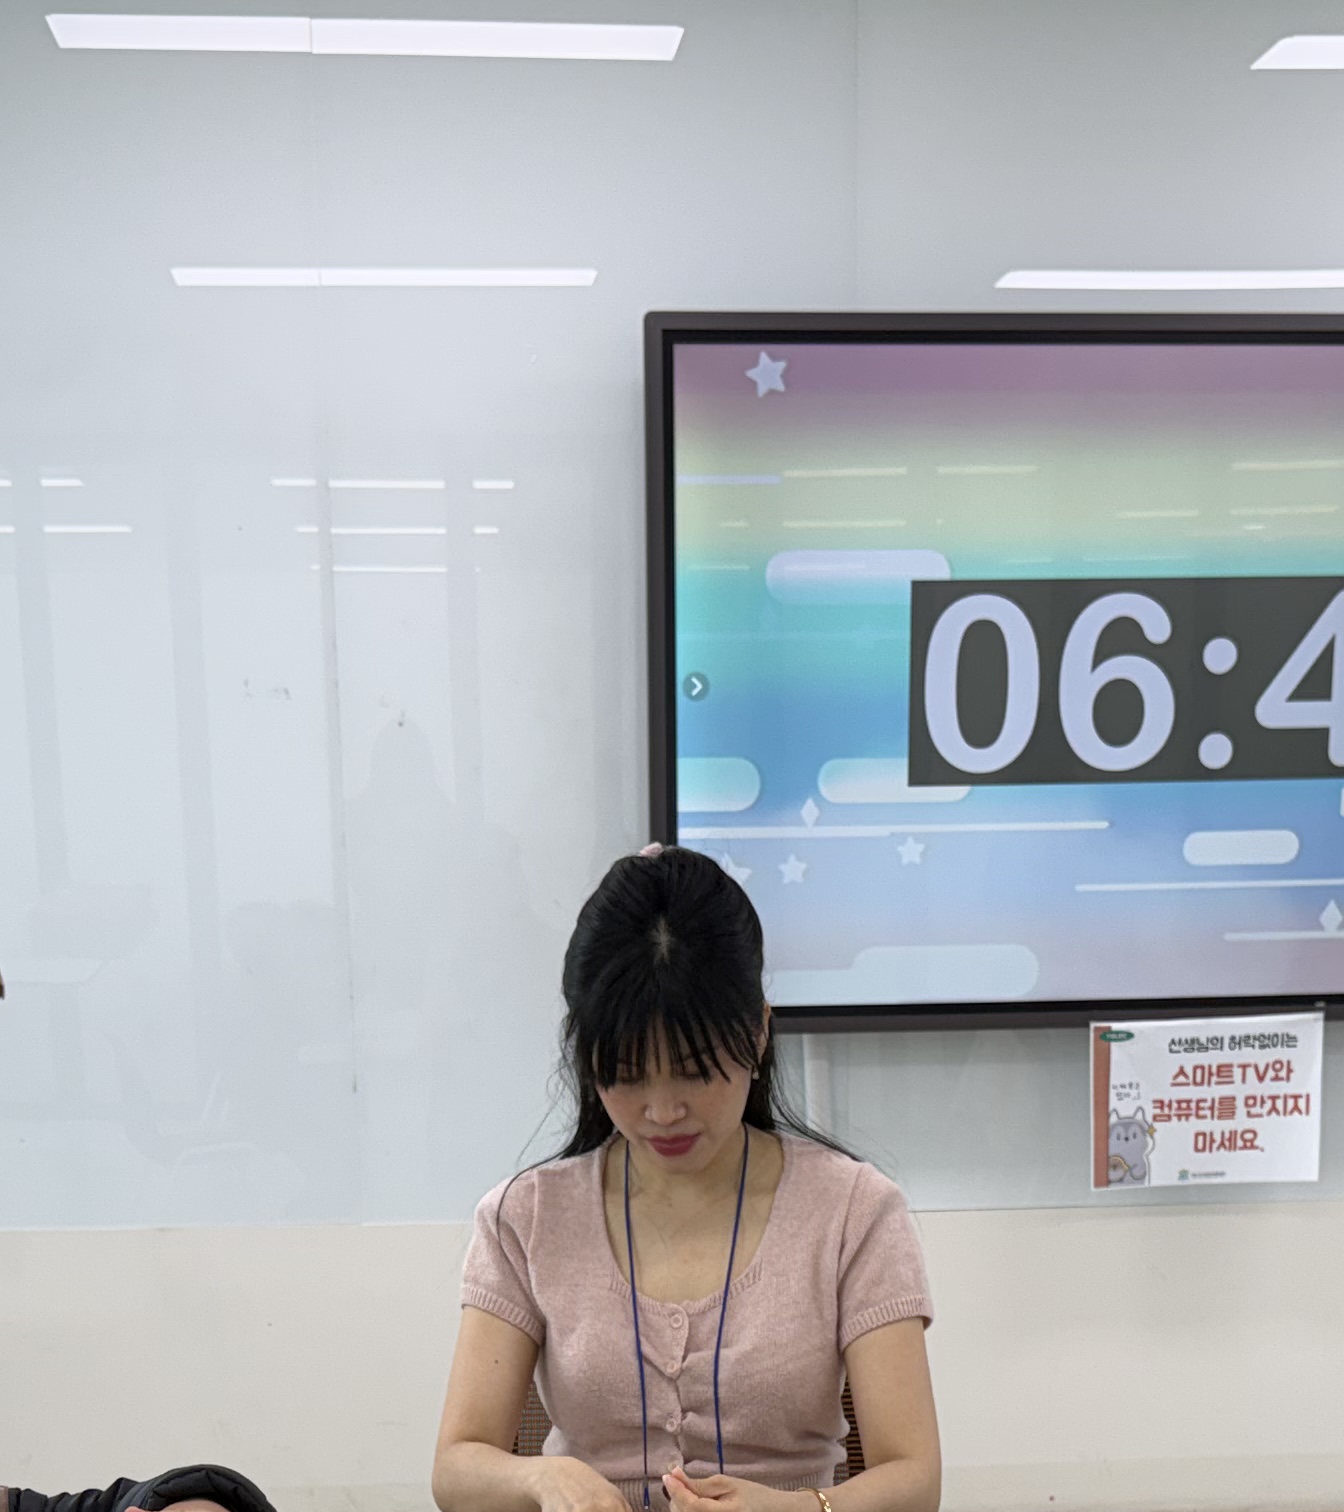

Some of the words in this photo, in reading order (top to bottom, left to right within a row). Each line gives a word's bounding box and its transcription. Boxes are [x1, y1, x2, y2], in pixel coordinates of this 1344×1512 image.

[1168, 1034, 1224, 1054] 선생님의
[1228, 1031, 1299, 1050] 허락없이는
[1170, 1059, 1294, 1087] 스마트TV와
[1152, 1095, 1237, 1123] 컴퓨터를
[1244, 1092, 1311, 1118] 만지지
[1193, 1129, 1265, 1153] 마세요.
